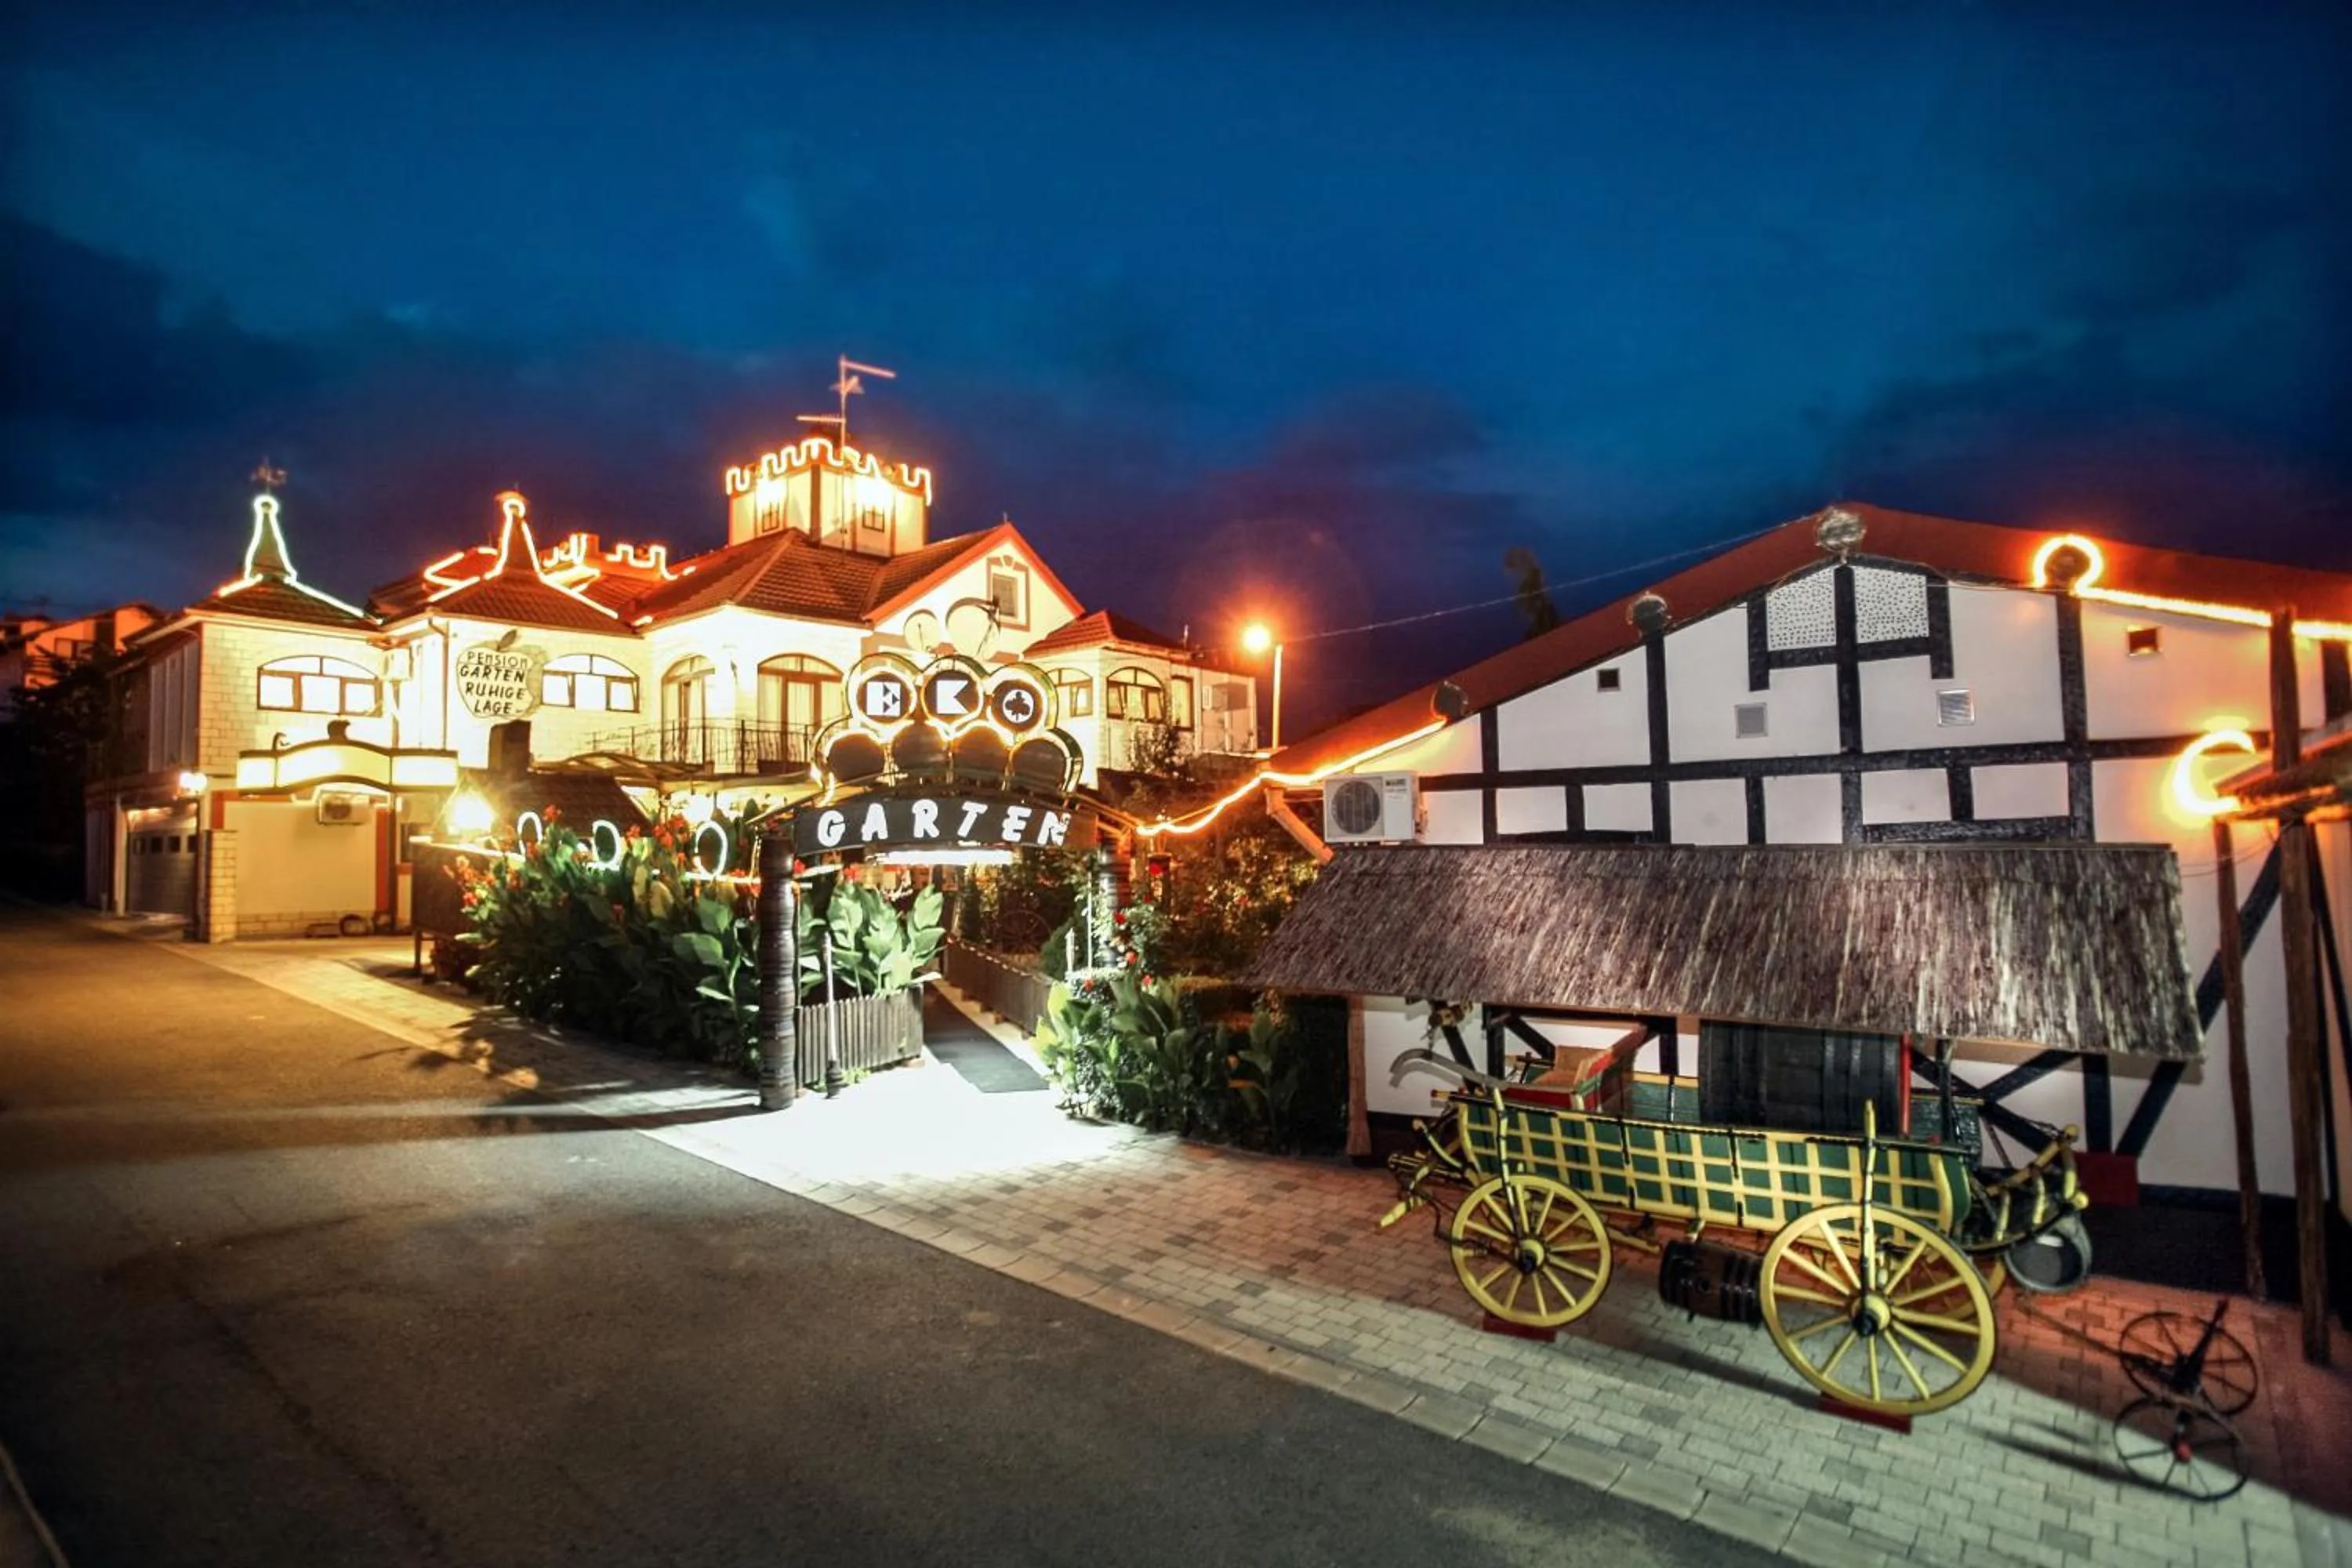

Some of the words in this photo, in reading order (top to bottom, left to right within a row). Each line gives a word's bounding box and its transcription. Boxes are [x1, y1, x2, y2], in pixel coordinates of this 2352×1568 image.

[466, 651, 528, 669] PENSION
[459, 664, 525, 683] GARTEN
[465, 682, 526, 700] RUHIGE
[474, 699, 514, 715] LAGE
[816, 798, 1072, 848] GARTEN
